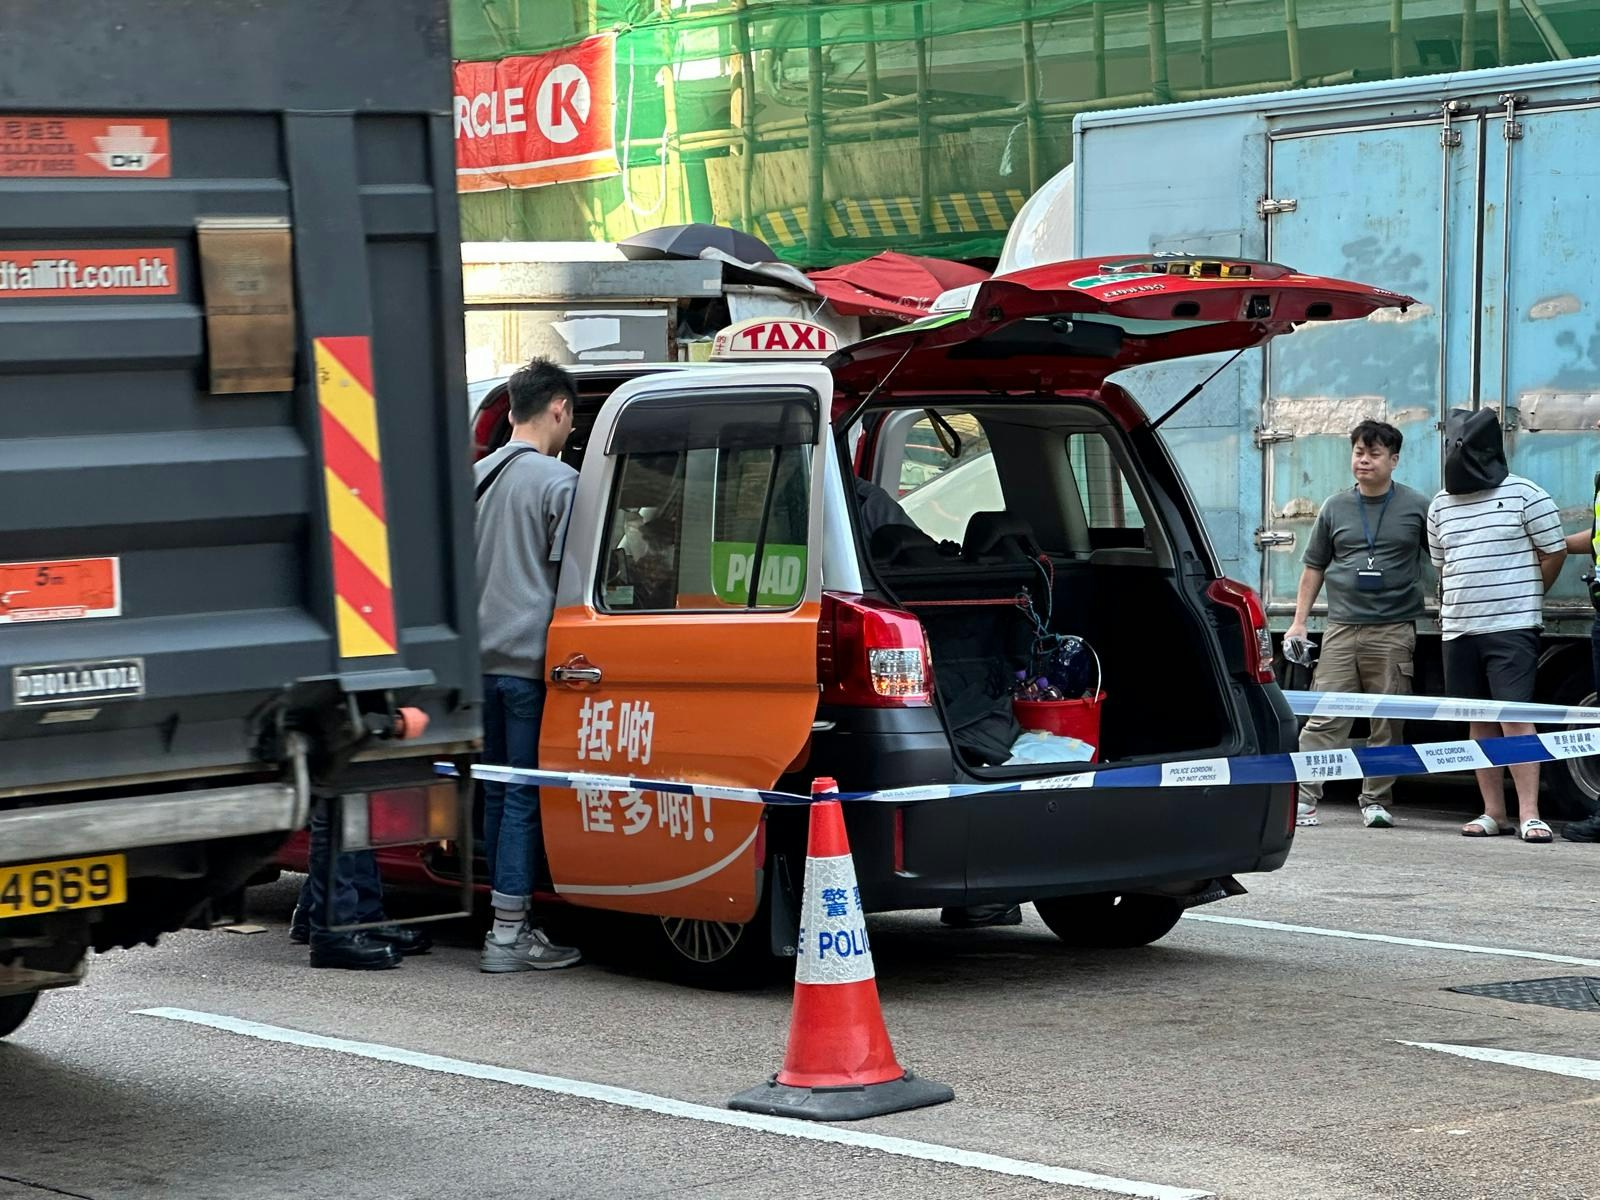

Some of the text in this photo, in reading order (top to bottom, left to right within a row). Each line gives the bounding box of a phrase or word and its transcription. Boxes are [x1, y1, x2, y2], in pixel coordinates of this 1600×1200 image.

[454, 87, 527, 139] RCLE
[111, 155, 143, 168] DH
[742, 323, 827, 350] TAXI
[577, 696, 655, 765] 抵啲
[1425, 748, 1443, 756] POLICE
[1437, 757, 1446, 765] DO
[1169, 767, 1189, 775] POLICE
[0, 863, 111, 911] 4669
